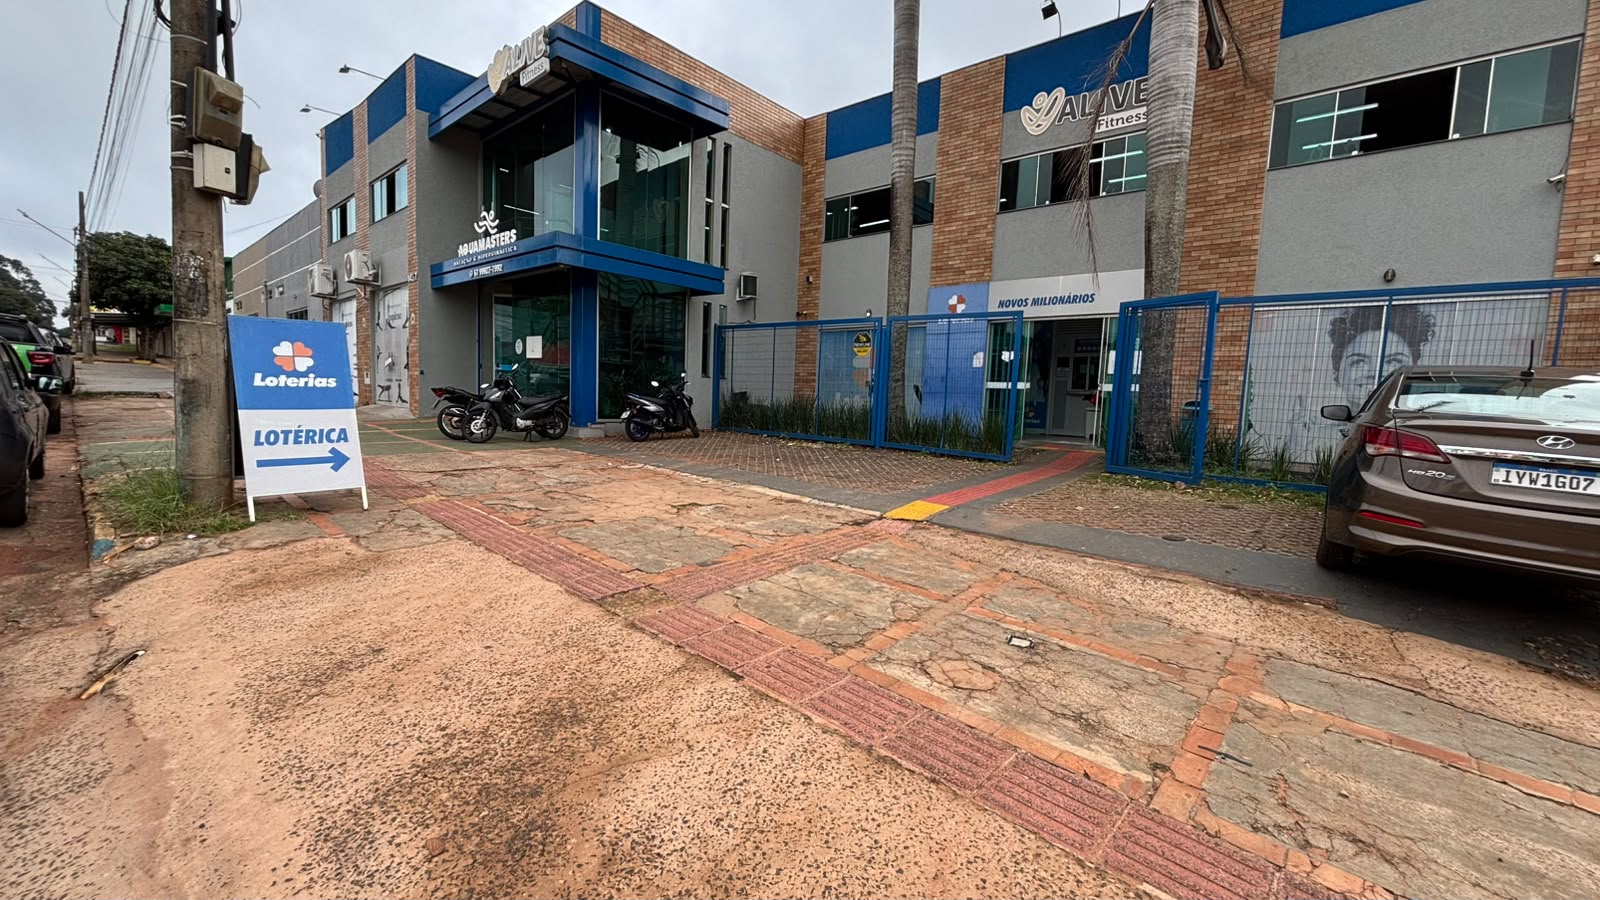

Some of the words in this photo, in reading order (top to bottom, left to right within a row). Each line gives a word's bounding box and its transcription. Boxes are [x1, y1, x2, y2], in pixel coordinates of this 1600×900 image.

[521, 61, 545, 82] Fitness
[457, 229, 517, 257] AQUAMASTERS
[997, 297, 1029, 309] NOVOS
[1030, 292, 1096, 307] MILIONÁRIOS
[253, 372, 337, 388] Loterias
[254, 425, 349, 446] LOTÉRICA
[1502, 470, 1595, 491] IYW1G07
